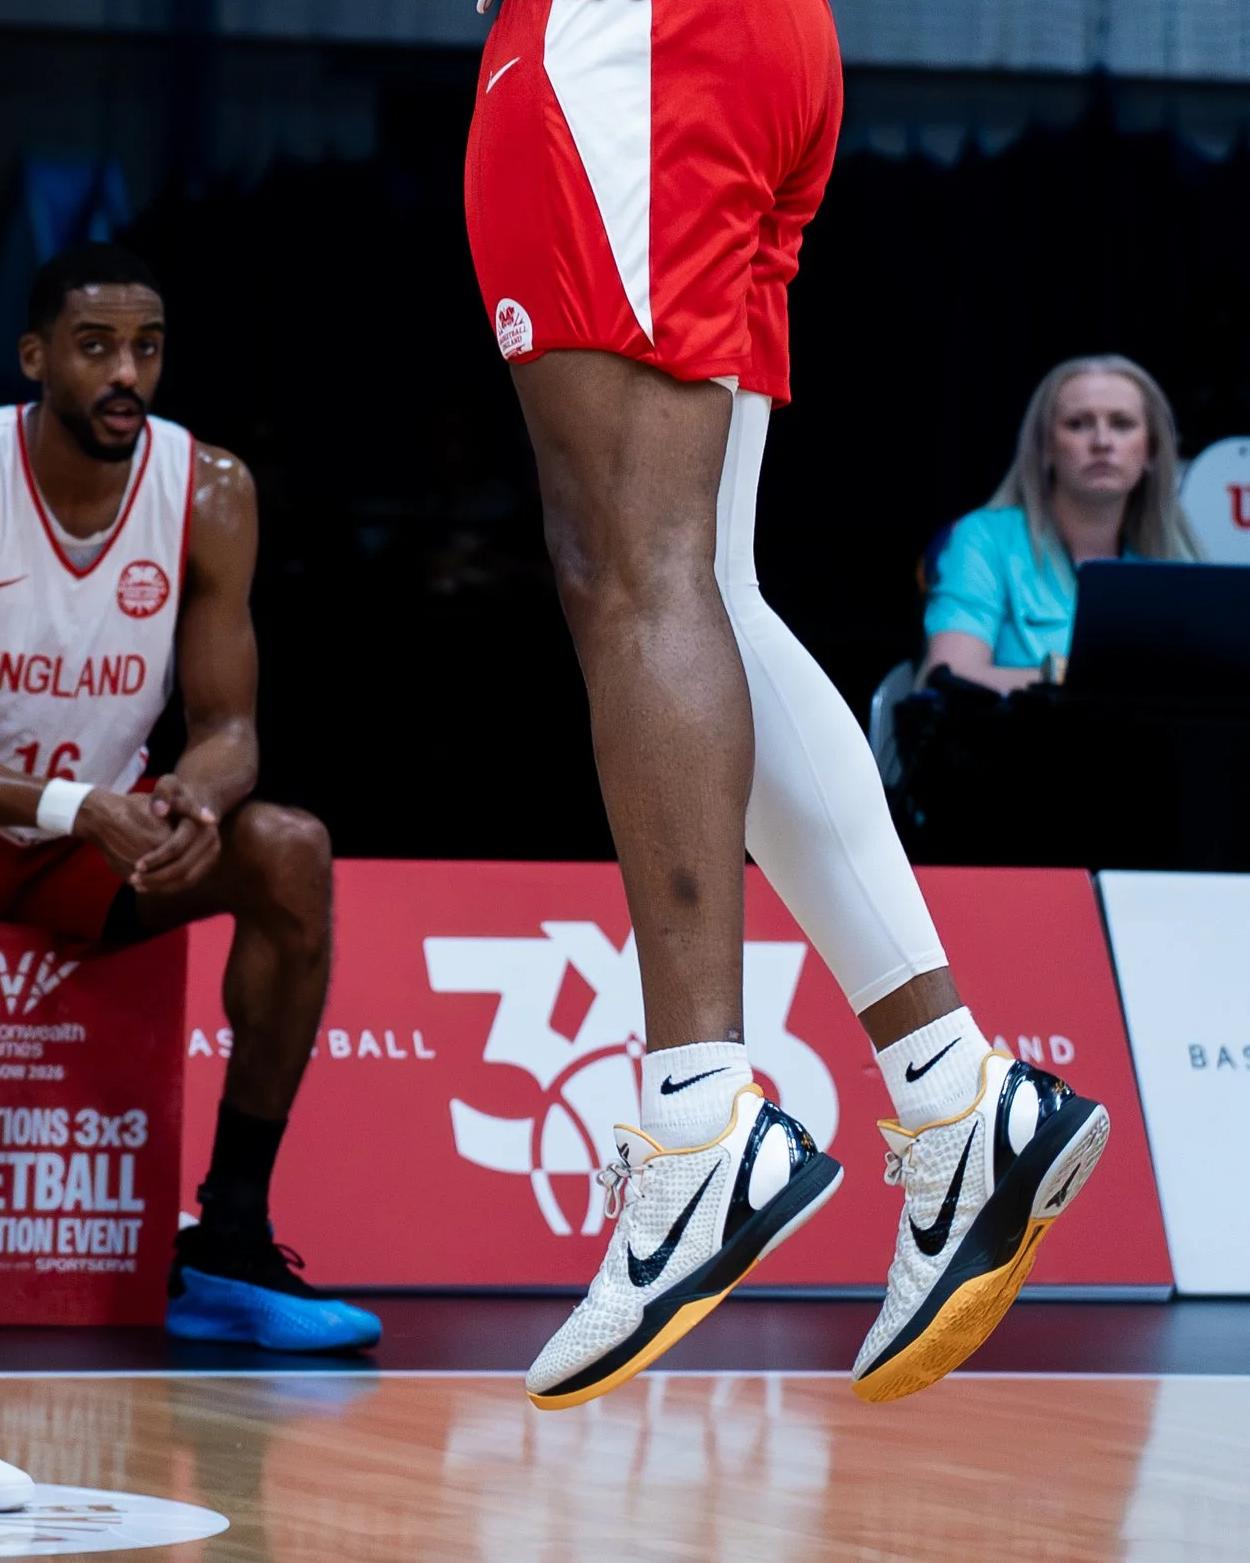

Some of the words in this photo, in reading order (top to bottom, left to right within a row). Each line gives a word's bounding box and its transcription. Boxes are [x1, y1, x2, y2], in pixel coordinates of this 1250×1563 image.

[15, 741, 80, 781] 16
[73, 1108, 148, 1148] 3x3
[57, 1218, 143, 1255] EVENT
